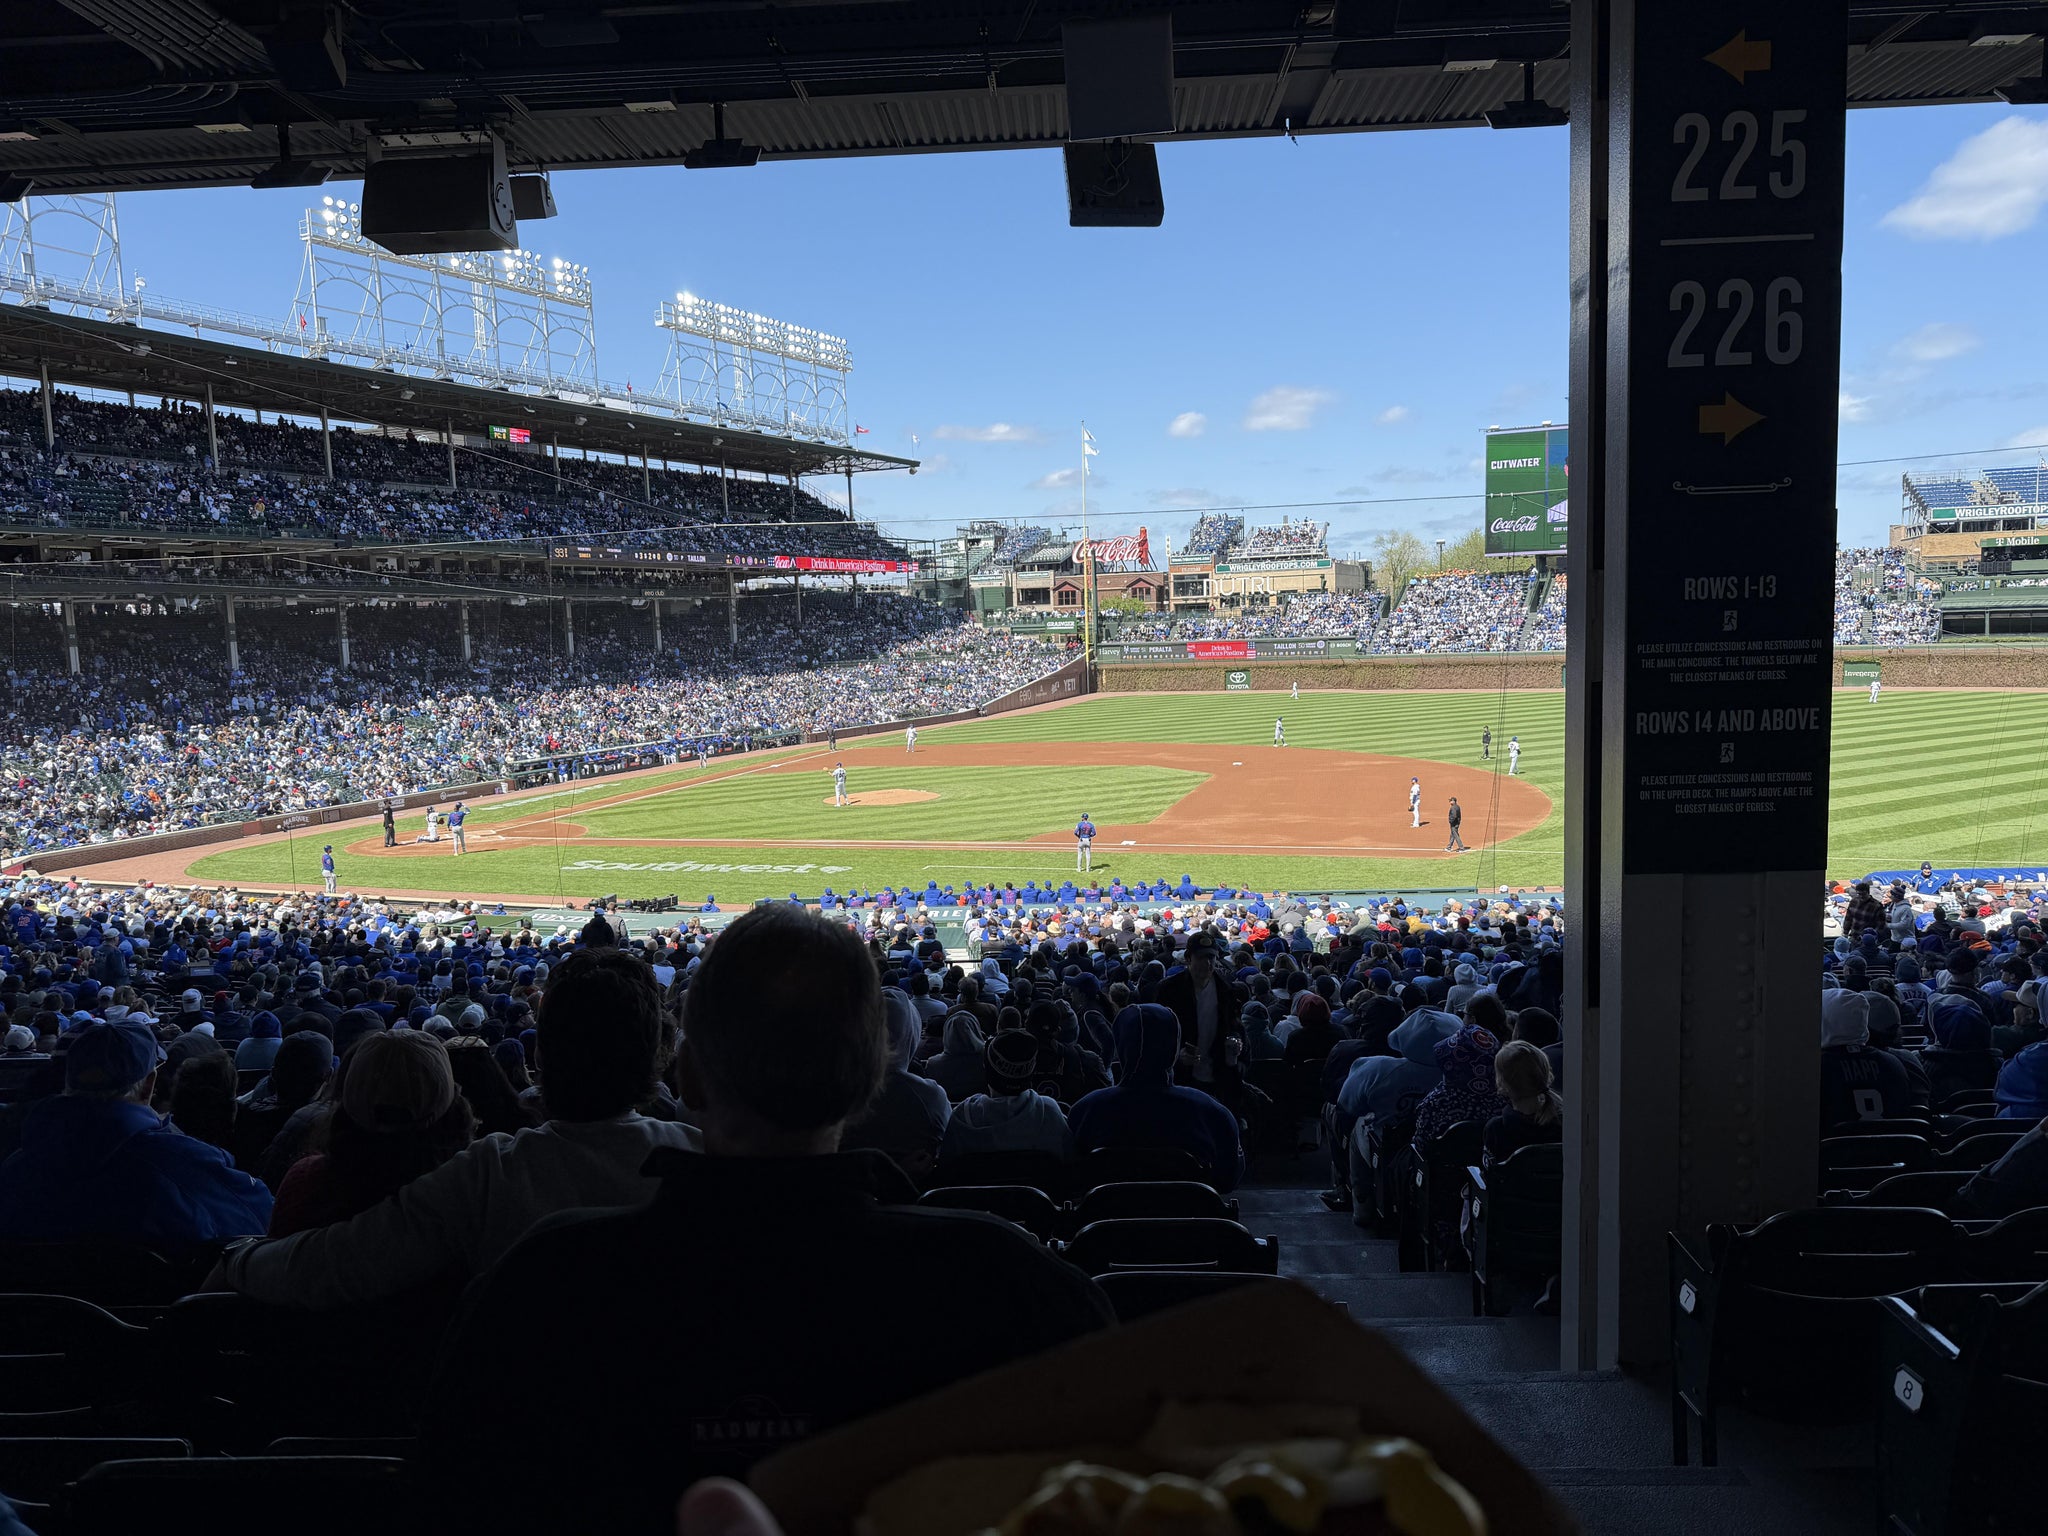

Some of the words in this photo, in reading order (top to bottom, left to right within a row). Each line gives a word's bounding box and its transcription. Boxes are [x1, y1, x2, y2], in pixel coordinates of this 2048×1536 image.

[1671, 109, 1807, 202] 225
[1667, 277, 1804, 368] 226
[1491, 458, 1540, 469] CUTWATER
[1954, 505, 2048, 518] WRIGLEYROOFTOP
[1491, 516, 1540, 533] Coca-Cola
[2006, 536, 2040, 546] Mobile
[1072, 536, 1144, 564] Coca-Cola
[811, 558, 828, 569] Drink
[836, 560, 862, 570] America's
[863, 561, 886, 571] Pastime
[1230, 561, 1318, 572] WRIGLEYROOFTOPS.COM
[1684, 576, 1738, 600] ROWS
[1744, 574, 1777, 599] 1-13
[1100, 646, 1120, 656] Harvey
[1637, 642, 1666, 654] PLEASE
[1666, 642, 1694, 652] UTILIZE
[1694, 640, 1747, 652] CONCESSIONS
[1747, 640, 1764, 651] AND
[1764, 638, 1810, 651] RESTROOMS
[1812, 638, 1822, 649] ON
[1642, 658, 1656, 669] THE
[1657, 658, 1676, 668] MAIN
[1725, 656, 1740, 666] THE
[1741, 655, 1775, 666] TUNNELS
[1776, 654, 1802, 666] BELOW
[1802, 654, 1818, 664] ARE
[1670, 672, 1684, 683] THE
[1684, 671, 1718, 682] CLOSEST
[1718, 670, 1744, 681] MEANS
[1745, 670, 1756, 680] OF
[1758, 670, 1788, 680] EGRESS.
[1844, 670, 1879, 678] Invenergy
[1064, 678, 1076, 692] YETI
[1636, 710, 1690, 735] ROWS
[1695, 710, 1712, 733] 14
[1717, 709, 1755, 732] AND
[1760, 708, 1820, 732] ABOVE
[1641, 775, 1668, 786] PLEASE
[1670, 774, 1697, 785] UTILIZE
[1698, 772, 1750, 784] CONCESSIONS
[1750, 772, 1766, 783] AND
[1767, 771, 1812, 782] RESTROOMS
[1640, 790, 1650, 801] ON
[1652, 790, 1666, 800] THE
[1667, 789, 1691, 800] UPPER
[1714, 788, 1729, 798] THE
[1730, 788, 1757, 798] RAMPS
[1758, 786, 1782, 798] ABOVE
[1784, 786, 1798, 796] ARE
[1799, 786, 1814, 796] THE
[1675, 803, 1708, 814] CLOSEST
[1708, 802, 1734, 813] MEANS
[1734, 802, 1746, 812] OF
[1746, 801, 1776, 812] EGRESS.
[283, 816, 310, 826] MARQUEE
[561, 860, 816, 873] Southwest
[1903, 1380, 1914, 1400] 8
[696, 1418, 806, 1441] RADWEAR
